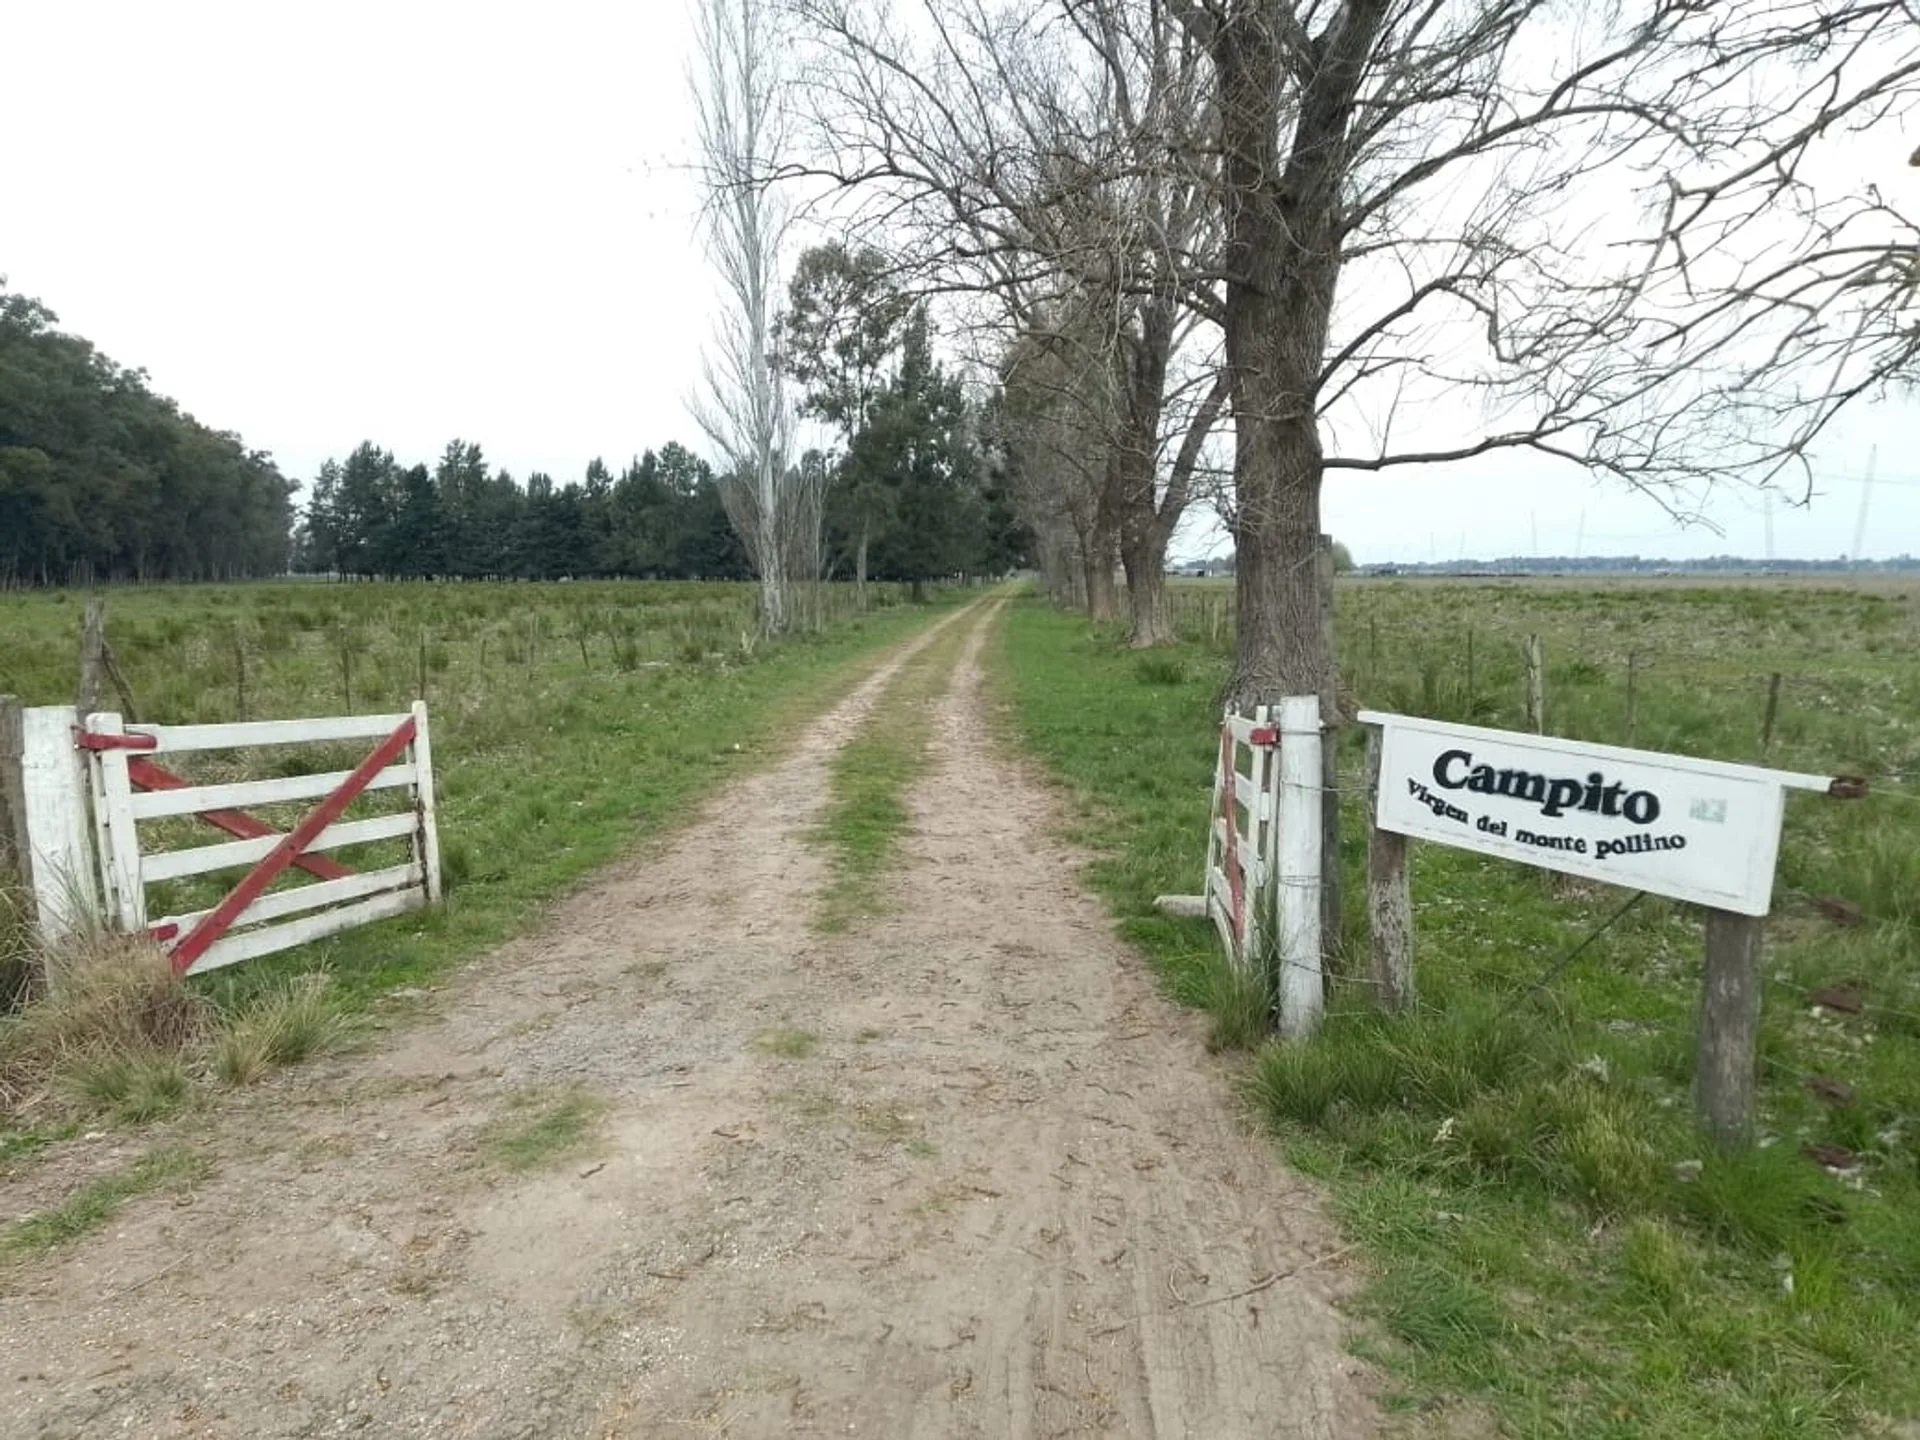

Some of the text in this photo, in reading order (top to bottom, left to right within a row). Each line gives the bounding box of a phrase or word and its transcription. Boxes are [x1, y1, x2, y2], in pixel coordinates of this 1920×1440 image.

[1407, 777, 1687, 860] Virgen del monte pollino
[1432, 749, 1660, 825] Campito
